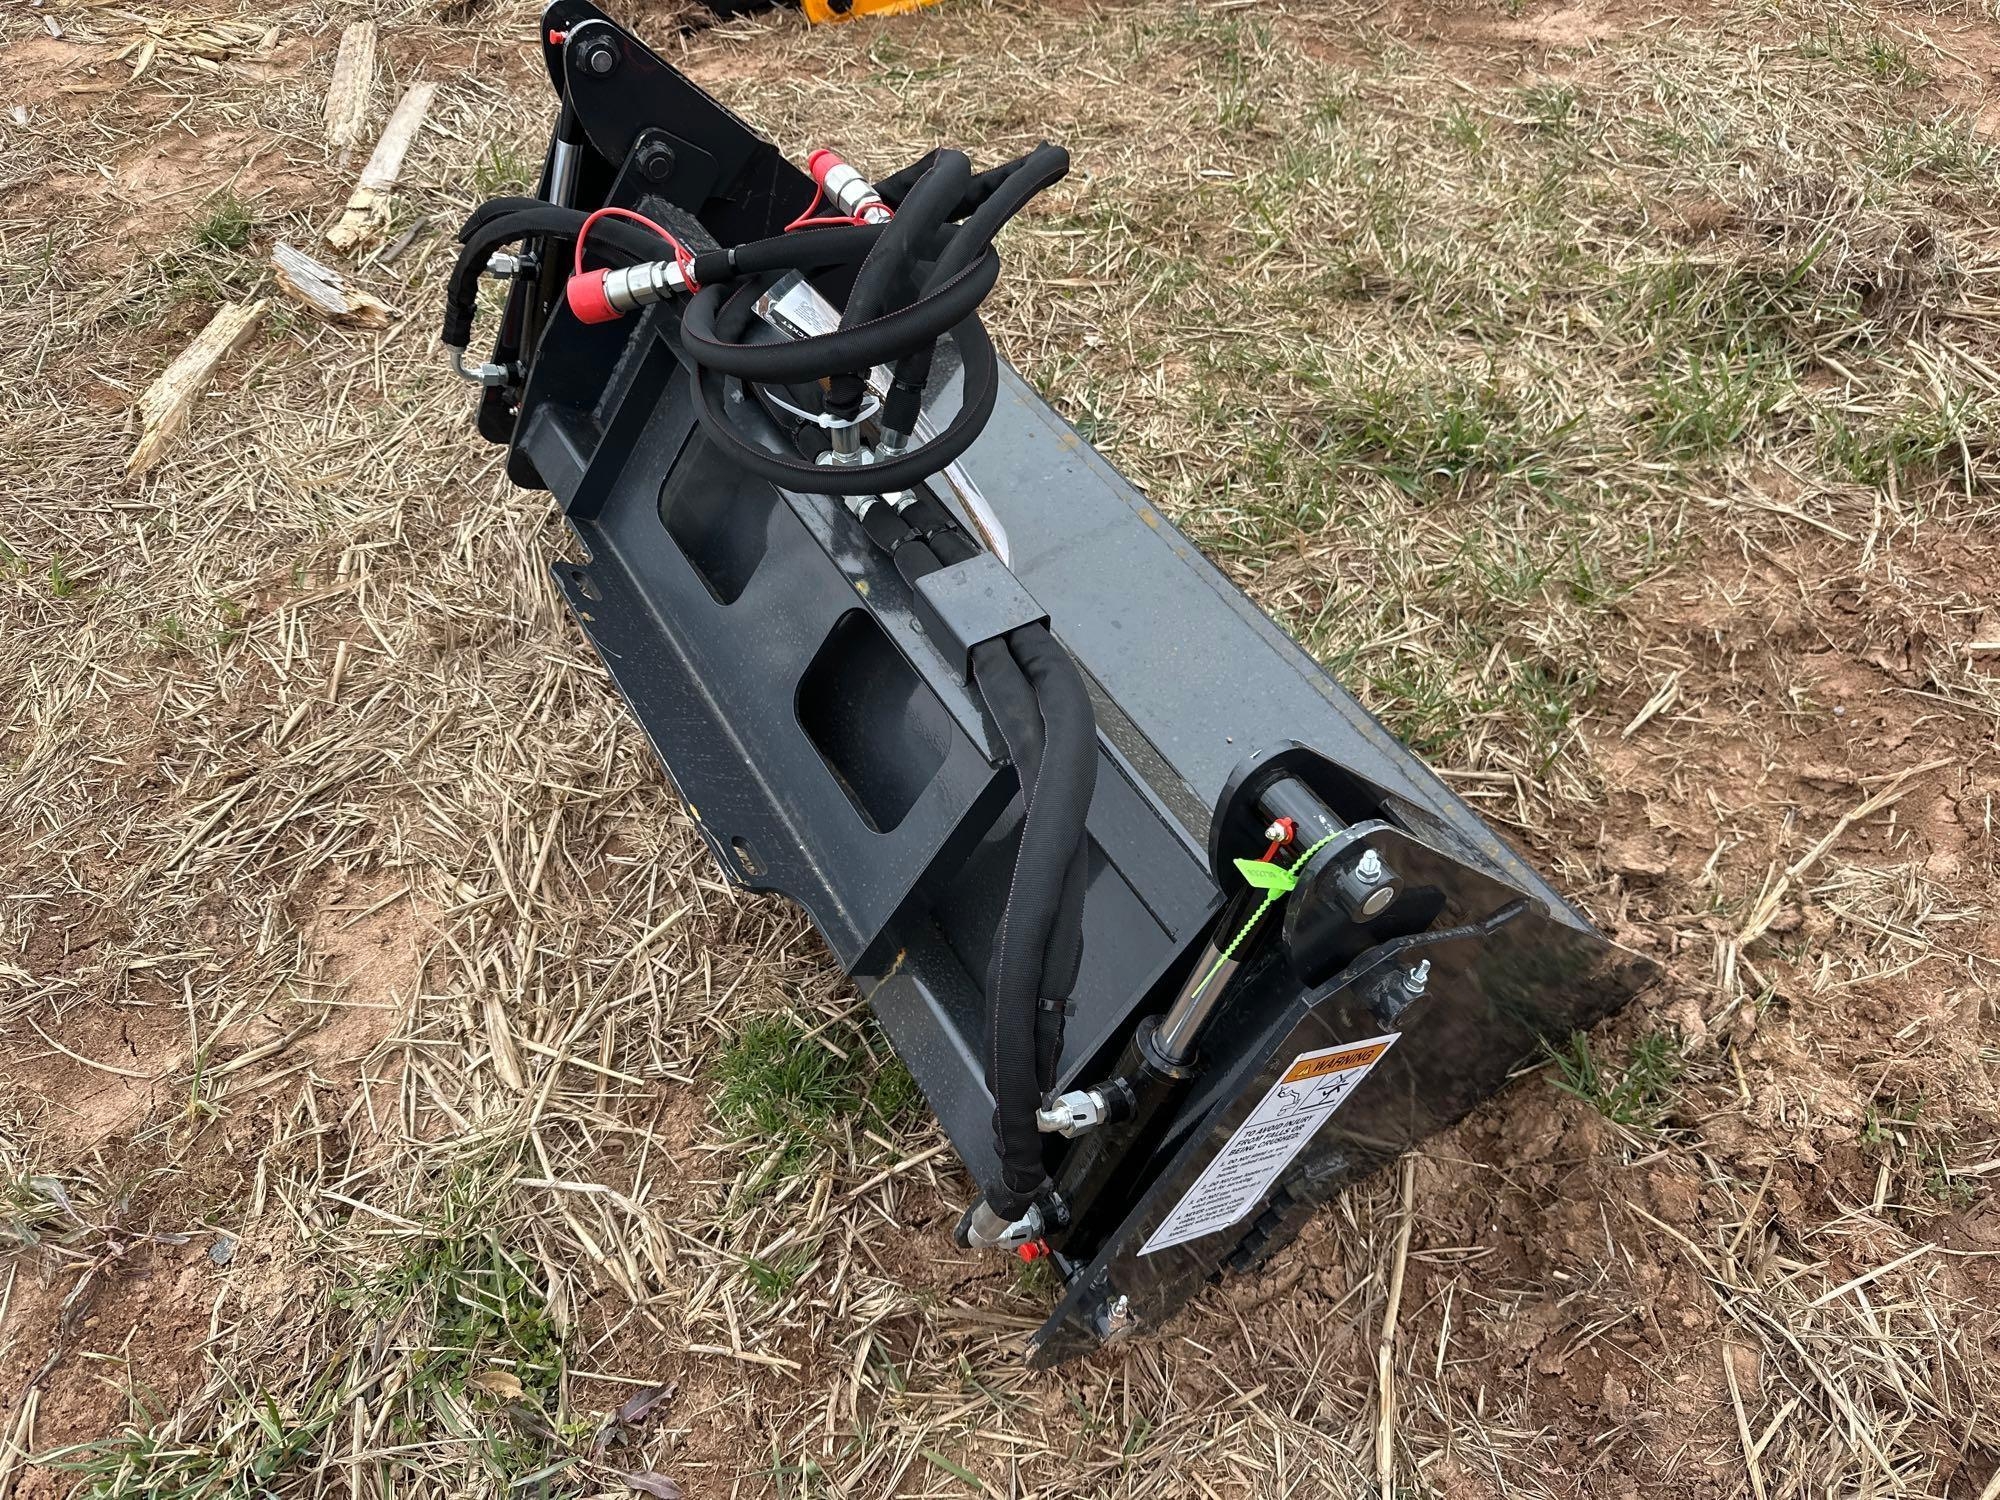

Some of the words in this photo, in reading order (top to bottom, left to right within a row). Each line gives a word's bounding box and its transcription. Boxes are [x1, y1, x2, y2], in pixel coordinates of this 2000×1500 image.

[780, 320, 807, 339] CKET
[1312, 1049, 1375, 1072] WARNING
[1235, 1135, 1264, 1148] FROM
[1263, 1127, 1291, 1140] FALLS
[1291, 1124, 1305, 1133] OR
[1243, 1130, 1257, 1138] TO
[1255, 1122, 1284, 1135] AVOID
[1283, 1115, 1313, 1128] INJURY
[1228, 1144, 1257, 1156] BEING
[1185, 1208, 1205, 1217] NEVER
